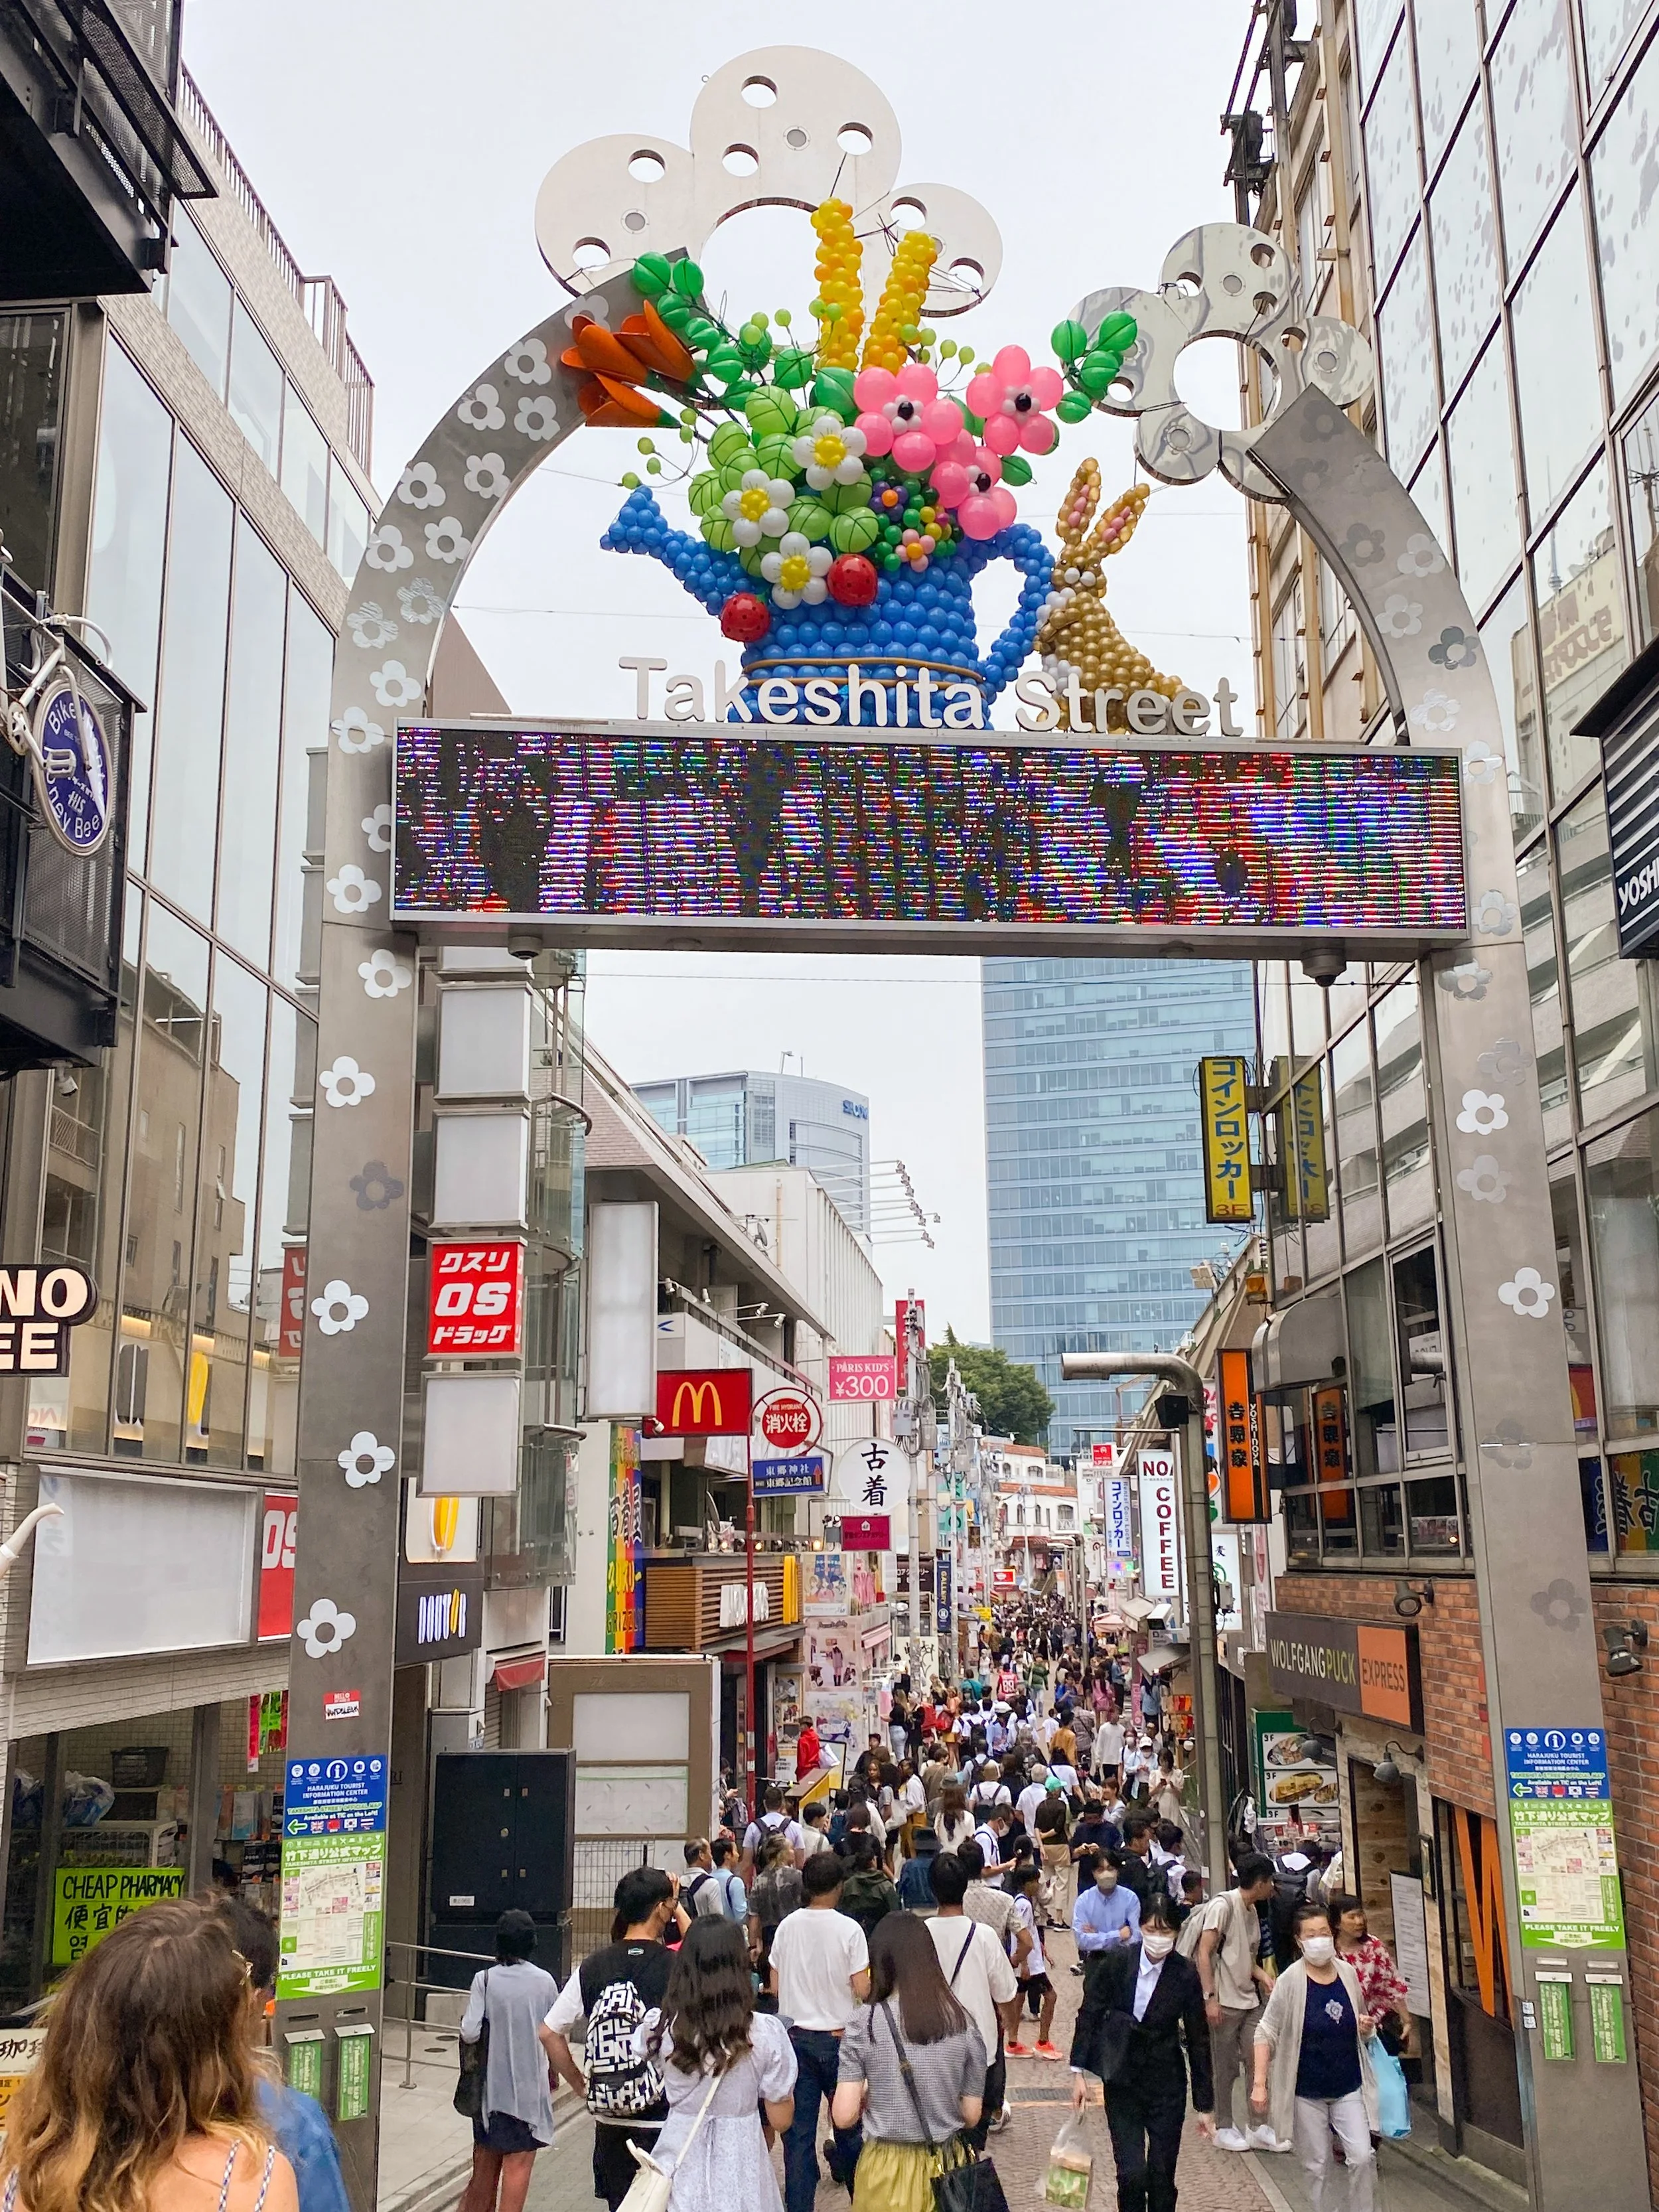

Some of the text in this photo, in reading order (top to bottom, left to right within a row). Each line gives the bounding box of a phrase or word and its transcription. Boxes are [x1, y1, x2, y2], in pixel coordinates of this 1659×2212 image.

[618, 656, 1244, 737] Takeshita Street
[48, 700, 76, 735] Bike
[75, 814, 100, 838] Bee
[1211, 1061, 1244, 1199] コインロッカー
[1216, 1204, 1248, 1216] 3F
[439, 1252, 510, 1273] クスリ
[435, 1282, 512, 1317] OS
[433, 1325, 512, 1345] ドラッグ
[836, 1361, 889, 1372] PARIS KID'S
[835, 1374, 889, 1398] ¥300
[766, 1412, 808, 1434] 消火栓
[766, 1463, 810, 1477] 東郷神社
[861, 1443, 889, 1507] 古着
[766, 1477, 812, 1488] 東郷記念館
[1112, 1481, 1123, 1549] コインロッカー
[1156, 1487, 1174, 1589] COFFEE
[1270, 1639, 1405, 1692] WOLFGANG PUCK EXPRESS
[307, 1783, 339, 1792] HARAJUKU
[1514, 1810, 1610, 1821] 竹下通り公式マップ
[285, 1843, 382, 1862] 竹下通り公式マップ
[63, 1874, 185, 1899] CHEAP PHARMACY
[281, 1971, 311, 1980] PLEASE
[314, 1969, 335, 1978] TAKE
[346, 1964, 376, 1974] FREELY
